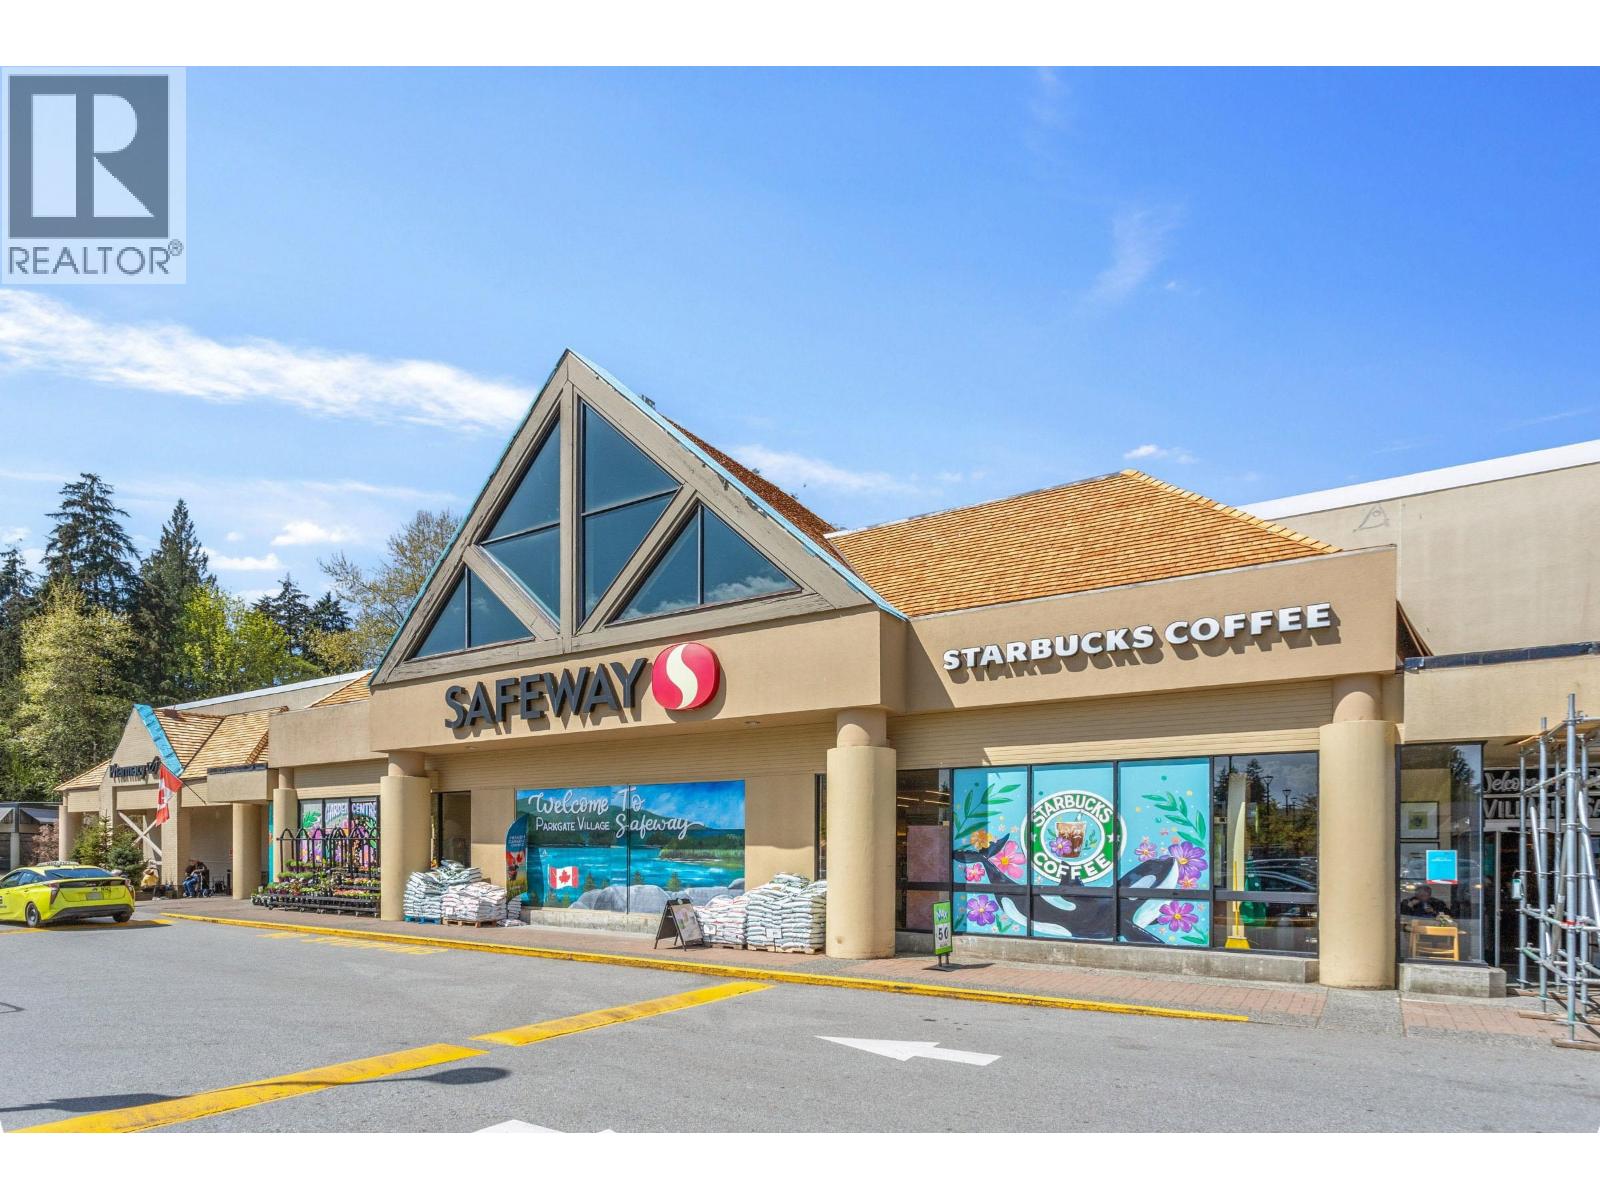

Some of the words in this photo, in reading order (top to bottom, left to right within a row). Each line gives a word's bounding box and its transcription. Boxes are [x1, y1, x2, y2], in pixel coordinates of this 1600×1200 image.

[943, 625, 1155, 671] STARBUCKS
[1164, 602, 1332, 645] COFFEE
[444, 657, 649, 729] SAFEWAY
[528, 789, 609, 815] Welcome
[617, 786, 646, 812] To
[1032, 794, 1114, 828] STARBUCKS
[535, 816, 576, 831] PARKGATE
[577, 816, 611, 832] VILLAGE
[615, 813, 705, 841] Safeway
[1033, 851, 1112, 880] COFFEE
